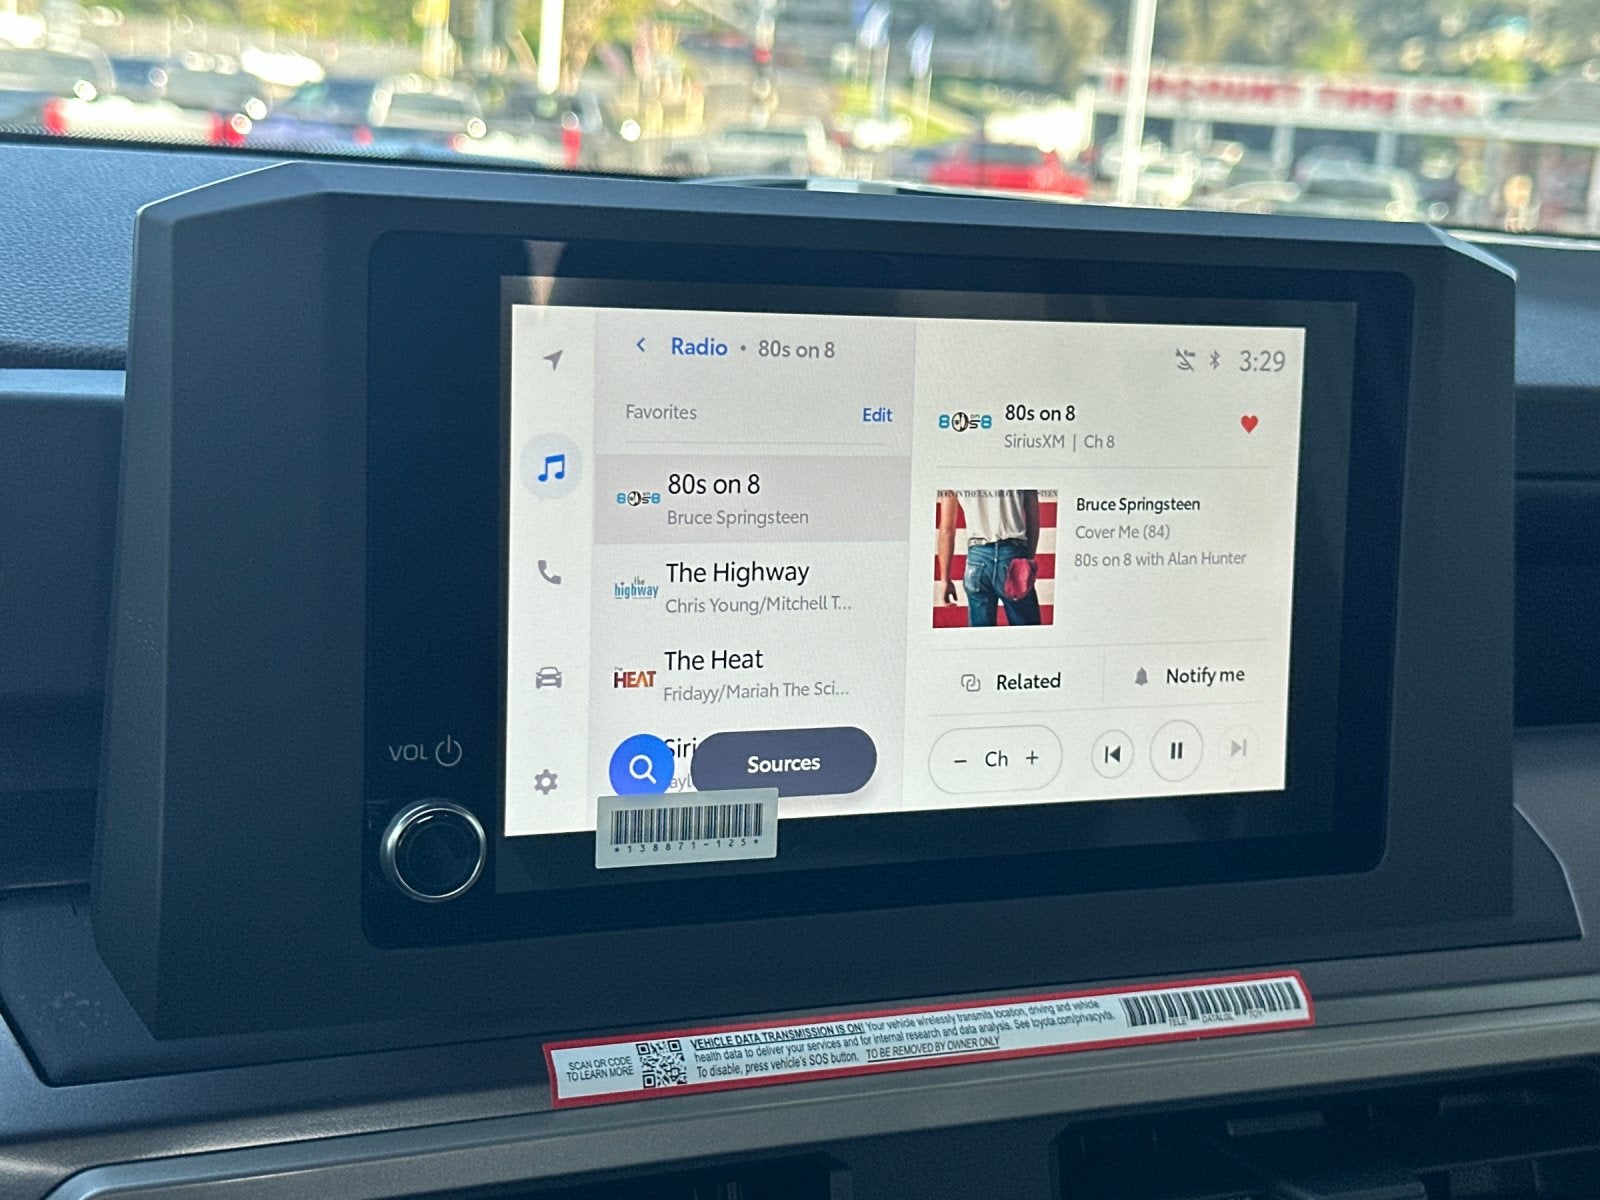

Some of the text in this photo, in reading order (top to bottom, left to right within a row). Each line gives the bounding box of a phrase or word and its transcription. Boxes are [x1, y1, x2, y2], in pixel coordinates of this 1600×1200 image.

[671, 337, 835, 359] Radio 80s on 8
[1239, 350, 1285, 372] 3:29
[625, 404, 697, 420] Favorites
[862, 407, 893, 423] Edit
[1005, 404, 1076, 422] 80s on 8
[1004, 434, 1115, 449] SiriusXM Ch 8
[668, 474, 760, 494] 80s on 8
[1077, 496, 1201, 514] Bruce Springsteen
[667, 509, 809, 528] Bruce Springsteen
[1075, 523, 1170, 541] Cover Me (84)
[1074, 551, 1247, 568] 80s on 8 with Alan Hunter
[667, 561, 810, 588] The Highway
[614, 581, 659, 600] highway
[665, 596, 852, 618] Chris Young/Mitchell T...
[664, 649, 764, 671] The Heat
[613, 671, 657, 689] HEAT
[996, 671, 1062, 691] Related
[1165, 667, 1246, 686] Notify me
[663, 681, 850, 704] Fridayy/Mariah The Sci...
[388, 744, 429, 761] VOL
[984, 749, 1009, 767] Ch
[746, 754, 822, 775] Sources
[690, 998, 1099, 1049] VEHICLE DATA TRANSMISSION IS ON! Your vehicle wirelessly transmits location, driving and vehicle
[695, 1050, 721, 1063] health
[723, 1048, 742, 1060] data
[745, 1047, 754, 1058] to
[757, 1042, 784, 1056] deliver
[787, 1043, 805, 1056] your
[808, 1038, 841, 1050] services
[844, 1036, 858, 1047] and
[861, 1034, 872, 1045] for
[874, 1031, 904, 1043] internal
[906, 1027, 941, 1040] research
[943, 1025, 957, 1036] and
[960, 1022, 977, 1035] data
[980, 1019, 1012, 1033] analysis.
[1015, 1018, 1030, 1029] See
[568, 1060, 593, 1071] SCAN
[607, 1055, 633, 1067] CODE
[697, 1066, 708, 1079] To
[709, 1061, 743, 1077] disable,
[745, 1061, 769, 1076] press
[809, 1053, 829, 1065] SOS
[831, 1051, 859, 1064] button.
[866, 1048, 879, 1059] TO
[880, 1047, 891, 1057] BE
[893, 1043, 934, 1056] REMOVED
[935, 1041, 946, 1052] BY
[947, 1037, 978, 1050] OWNER
[979, 1035, 999, 1047] ONLY
[566, 1065, 634, 1082] TO LEARN MORE
